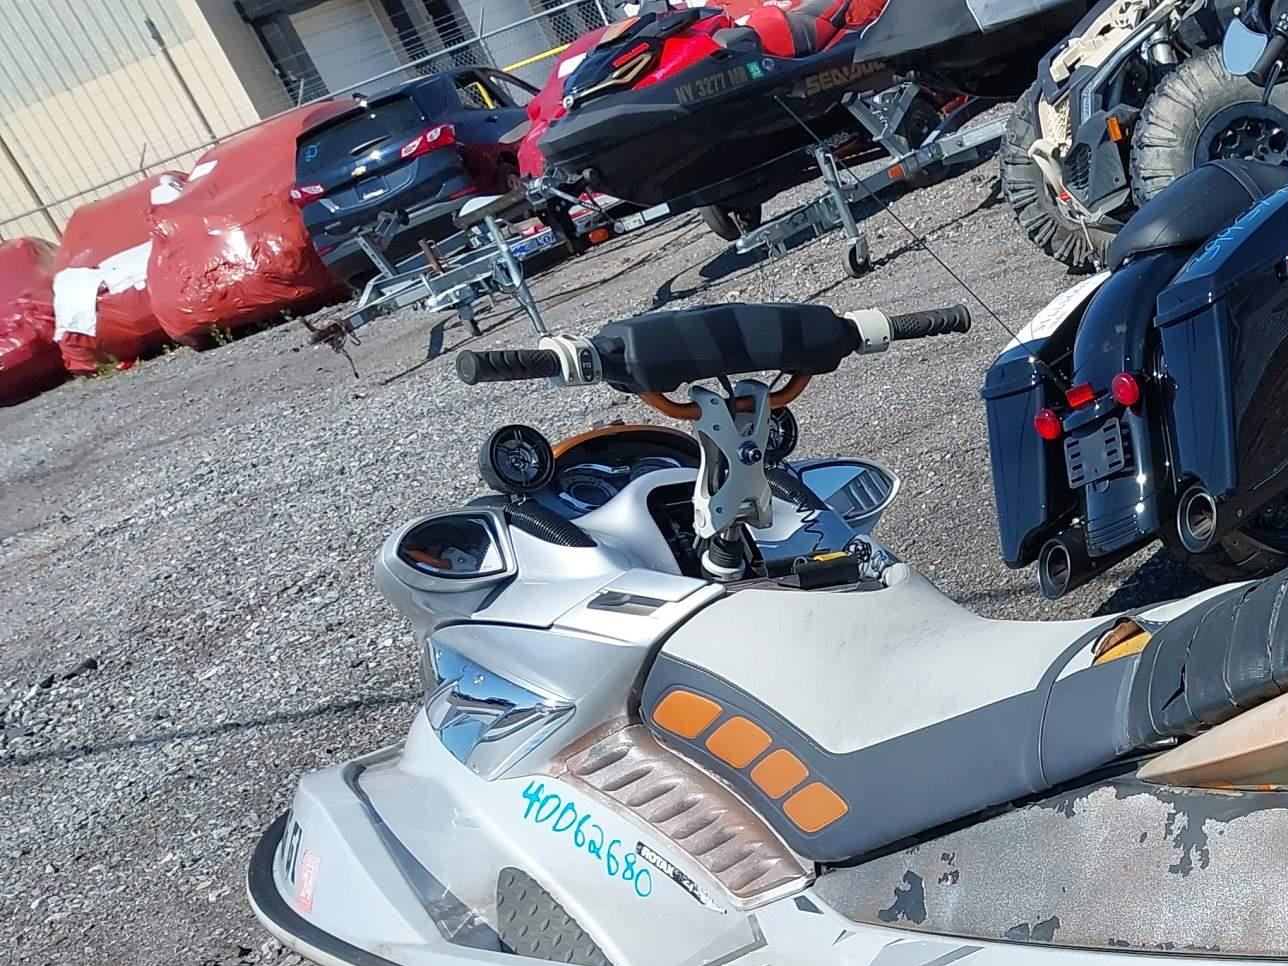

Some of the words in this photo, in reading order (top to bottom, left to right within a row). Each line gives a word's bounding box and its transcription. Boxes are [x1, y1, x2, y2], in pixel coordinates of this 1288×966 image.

[697, 72, 728, 98] 3277
[522, 780, 653, 897] 40062680
[640, 845, 675, 878] ROTAX
